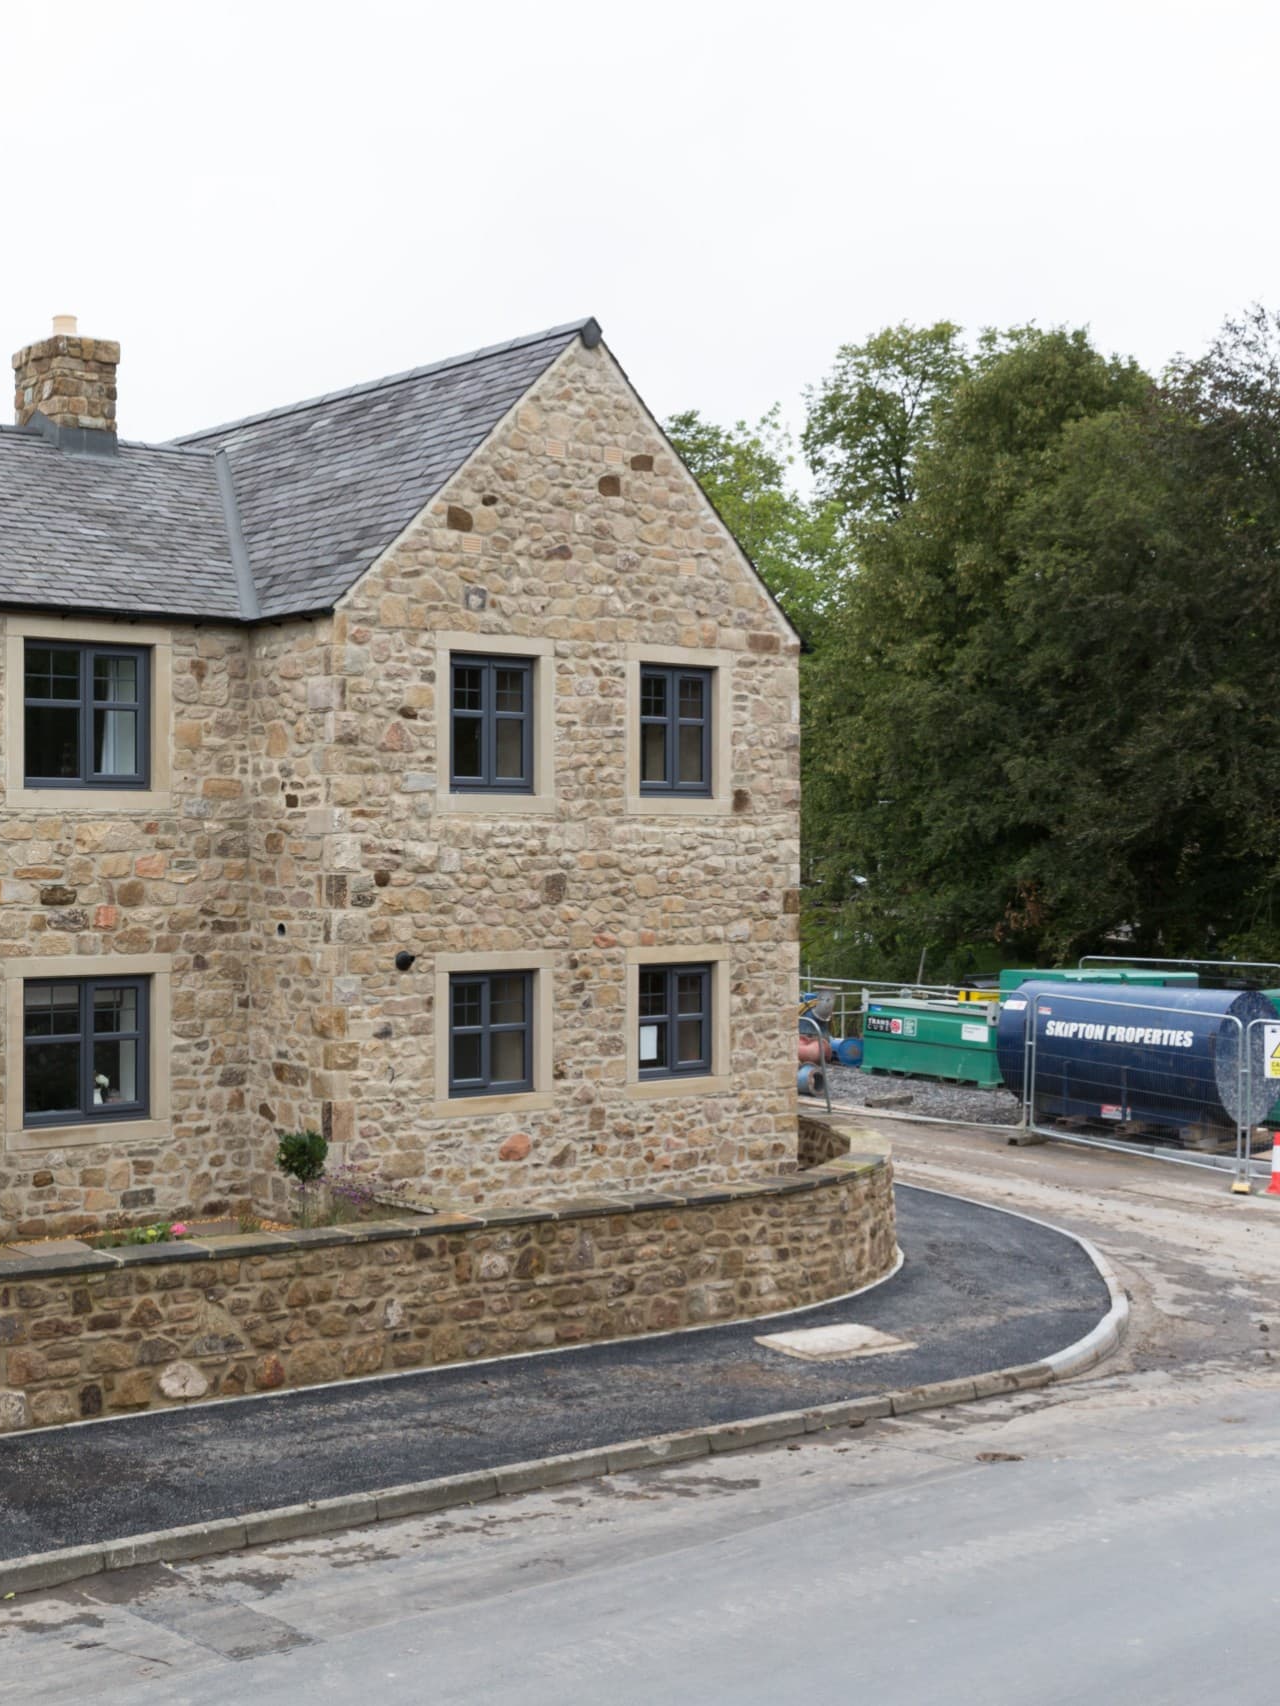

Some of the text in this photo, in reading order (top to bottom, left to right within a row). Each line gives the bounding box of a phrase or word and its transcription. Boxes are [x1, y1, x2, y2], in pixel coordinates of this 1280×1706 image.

[868, 1017, 890, 1026] TRANS
[1045, 1020, 1195, 1048] SKIPTON PROPERTIES
